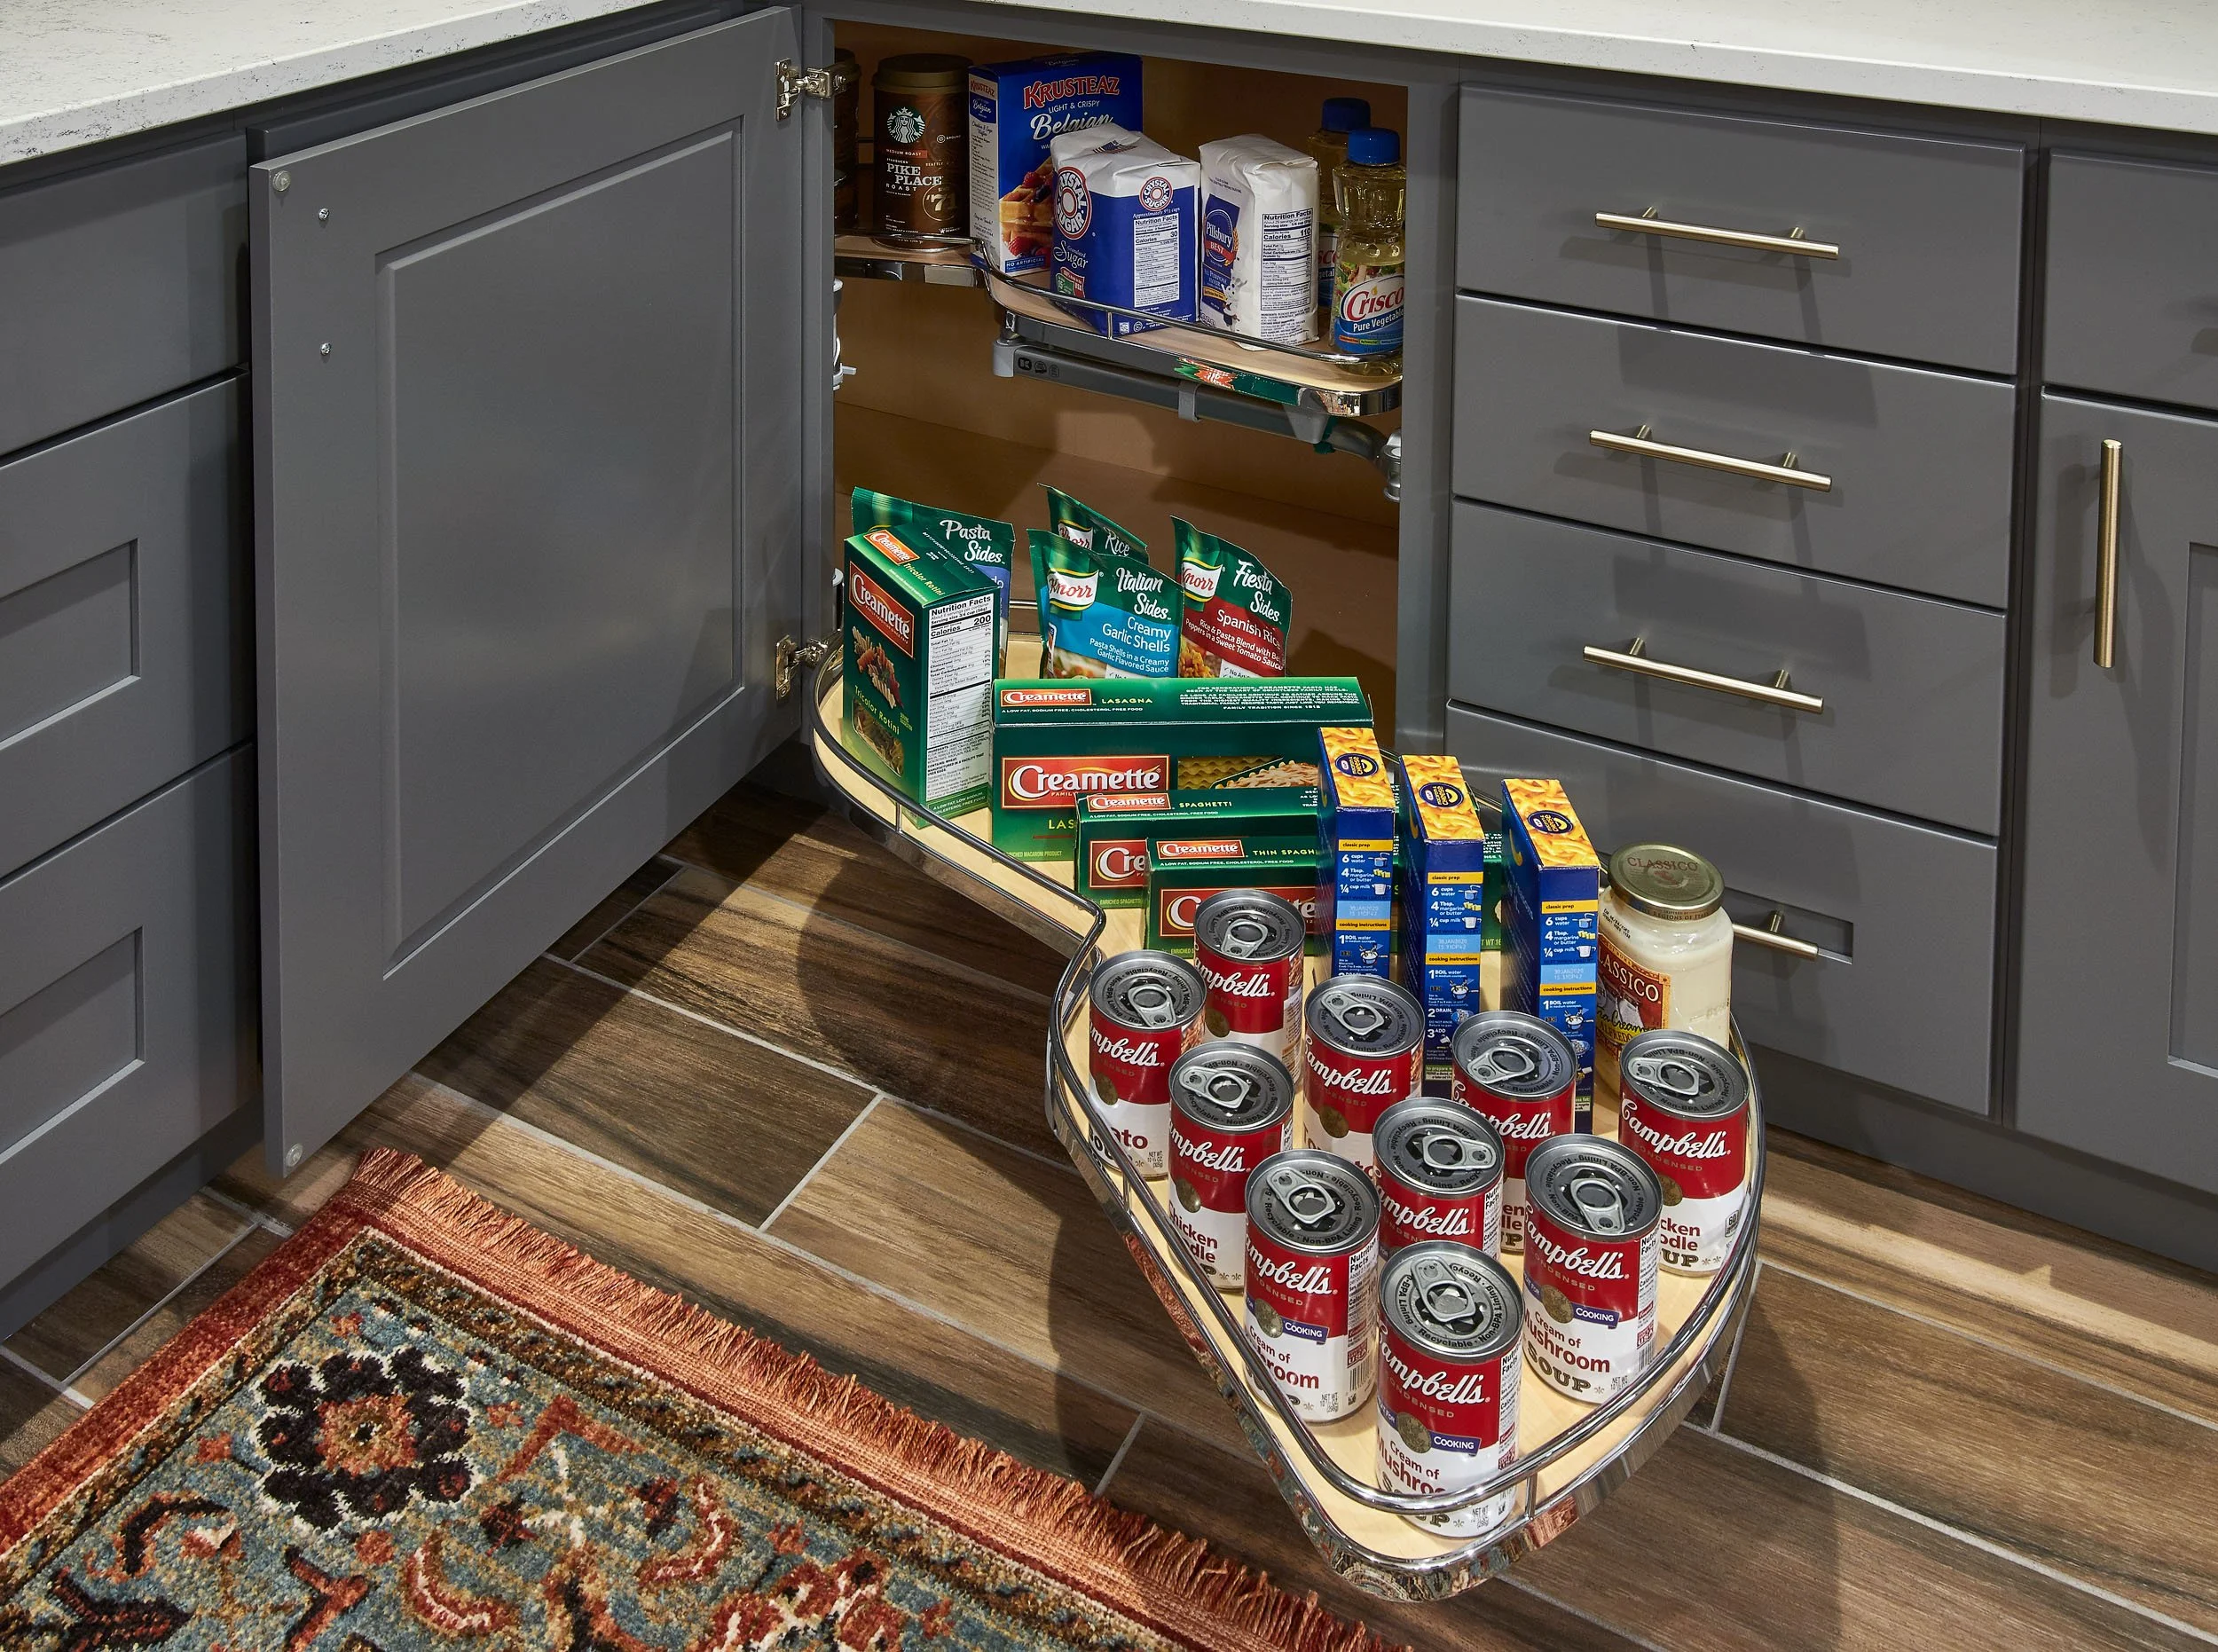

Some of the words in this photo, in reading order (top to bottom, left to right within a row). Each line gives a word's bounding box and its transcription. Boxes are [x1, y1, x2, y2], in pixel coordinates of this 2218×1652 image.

[970, 80, 995, 97] KRUSTEAZ
[1024, 75, 1120, 109] KRUSTEAZ
[1048, 103, 1068, 114] LIGHT
[887, 163, 921, 177] PIKE
[894, 175, 942, 185] PLACE
[885, 183, 917, 192] ROAST
[1144, 179, 1170, 196] CRYSTAL
[1144, 196, 1168, 208] SUGAR
[1206, 222, 1232, 248] Pillsbury
[1300, 228, 1311, 237] 110
[1053, 240, 1089, 269] Sugar
[1210, 241, 1225, 255] BEST
[1346, 287, 1404, 322] Crisco
[1353, 322, 1370, 333] Pure
[939, 520, 992, 541] Pasta
[1103, 527, 1130, 556] Rice
[869, 532, 910, 561] Creamette
[964, 540, 1003, 563] Sides
[903, 562, 927, 582] Tricolor
[924, 580, 946, 596] Rotini
[1115, 567, 1163, 594] Italian
[1183, 568, 1214, 591] Knorr
[1233, 559, 1272, 595] Fiesta
[1049, 578, 1094, 599] Knorr
[853, 573, 910, 640] Creamette
[931, 602, 967, 617] Nutrition
[969, 595, 991, 607] Facts
[1134, 593, 1168, 619] Sides
[1250, 591, 1280, 622] Sides
[931, 626, 961, 637] Calories
[973, 615, 991, 626] 200
[1128, 617, 1171, 641] Creamy
[1216, 609, 1261, 638] Spanish
[1263, 629, 1281, 649] Rice
[1103, 623, 1131, 645] Garlic
[1133, 636, 1170, 652] Shells
[1185, 618, 1206, 636] Peppers
[1215, 636, 1236, 650] Sweet
[1236, 645, 1261, 662] Tomato
[1262, 656, 1284, 671] Sauce
[1199, 619, 1211, 632] Rice
[1216, 628, 1235, 642] Pasta
[1236, 637, 1255, 651] Blend
[1255, 645, 1270, 657] with
[1089, 638, 1109, 650] Pasta
[1109, 644, 1126, 657] Shells
[1139, 656, 1169, 666] Creamy
[1097, 648, 1115, 662] Garlic
[1115, 657, 1144, 671] Flavored
[1145, 664, 1169, 673] Sauce
[1006, 691, 1087, 704] Creamette
[854, 685, 877, 714] Tricolor
[878, 711, 900, 736] Rotini
[1011, 765, 1160, 798] Creamette
[1093, 797, 1165, 808] Creamette
[1162, 843, 1239, 856] Creamette
[1627, 856, 1698, 872] CLASSICO
[1431, 887, 1439, 896] 6
[1430, 901, 1439, 910] 4
[1652, 909, 1684, 921] REGIONS
[1546, 916, 1553, 926] 6
[1545, 931, 1553, 941] 4
[1125, 967, 1164, 976] Recyclable
[1196, 958, 1271, 997] ampbell's
[1428, 970, 1435, 979] 1
[1599, 945, 1659, 1002] LASSICO
[1428, 1009, 1435, 1018] 2
[1543, 1000, 1549, 1010] 1
[1089, 1020, 1160, 1067] mpbell's
[1427, 1029, 1435, 1038] 3
[1475, 1029, 1518, 1045] Recyclable
[1666, 1048, 1706, 1063] Non-BPA
[1621, 1096, 1728, 1160] Campbell's
[1170, 1120, 1246, 1174] mpbell's
[1264, 1202, 1294, 1239] Recyclable
[1660, 1217, 1701, 1237] cken
[1728, 1214, 1736, 1225] 60
[1660, 1233, 1698, 1251] odle
[1246, 1233, 1332, 1295] ampbell's
[1350, 1256, 1369, 1273] Facts
[1661, 1248, 1699, 1268] UP
[1576, 1308, 1615, 1322] COOKING
[1285, 1322, 1323, 1338] COOKING
[1418, 1327, 1473, 1349] Recyclable
[1477, 1313, 1503, 1344] Non-BPA
[1535, 1311, 1565, 1342] Cream
[1569, 1337, 1582, 1349] of
[1249, 1326, 1276, 1357] Cream
[1278, 1353, 1291, 1364] of
[1524, 1308, 1610, 1373] Mushroom
[1378, 1320, 1486, 1404] Campbell's
[1502, 1356, 1518, 1375] Facts
[1527, 1342, 1591, 1393] SOUP
[1434, 1436, 1475, 1450] COOKING
[1390, 1440, 1422, 1474] Cream
[1426, 1468, 1440, 1480] of
